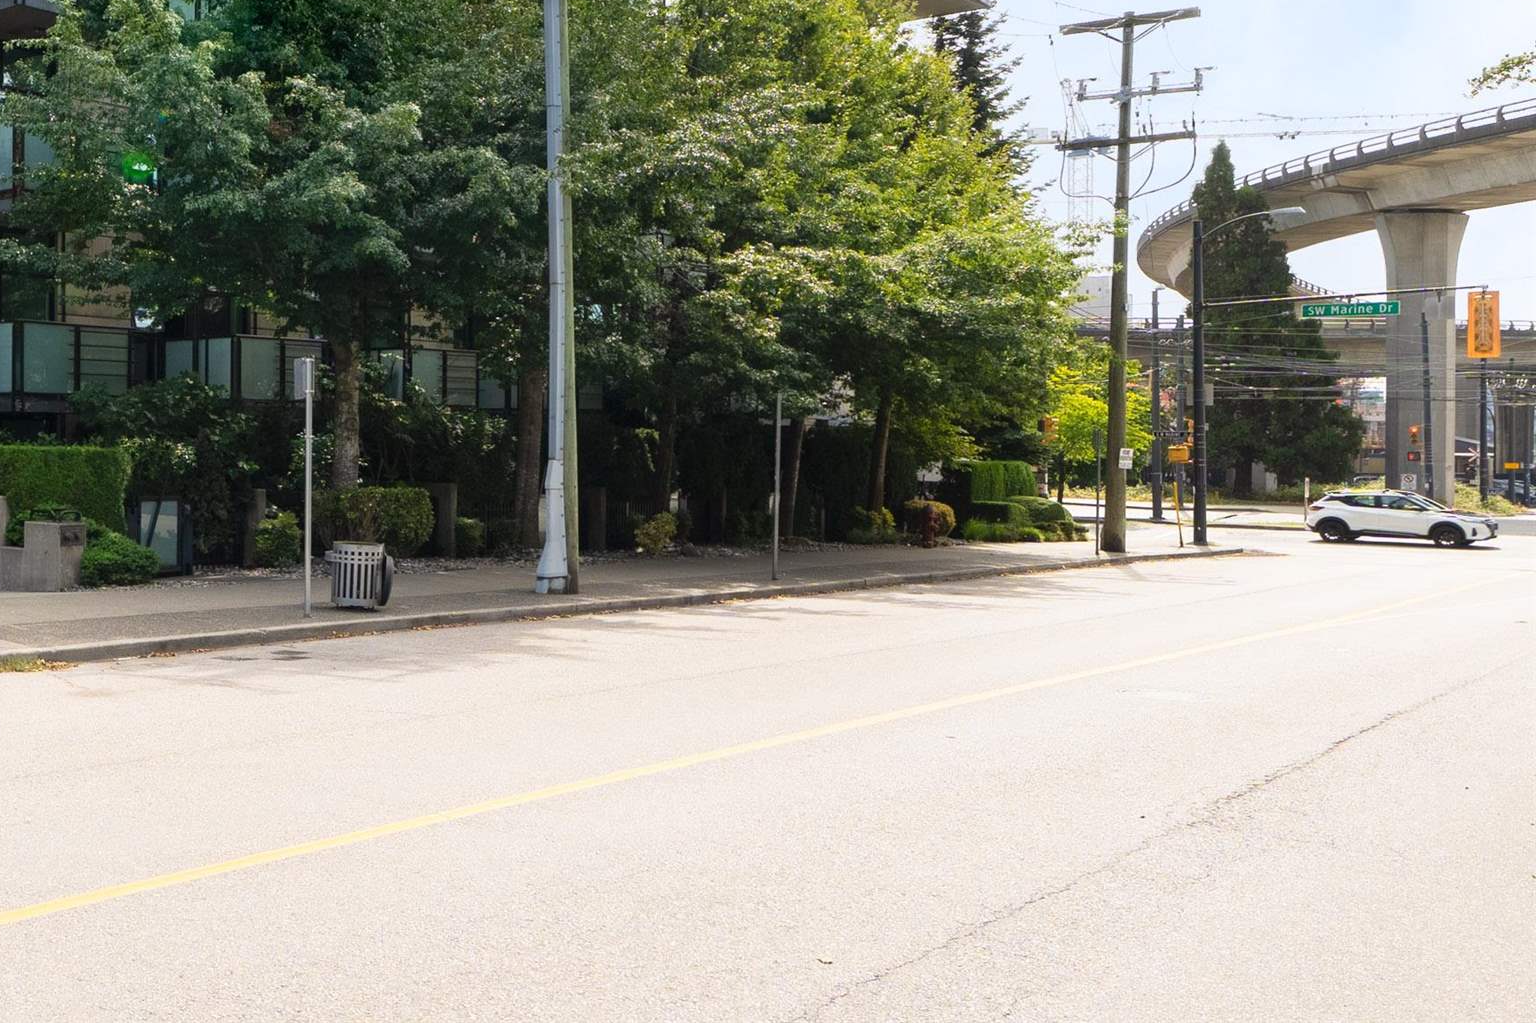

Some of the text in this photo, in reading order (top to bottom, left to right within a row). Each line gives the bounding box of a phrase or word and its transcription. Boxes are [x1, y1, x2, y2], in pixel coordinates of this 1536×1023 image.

[1308, 303, 1393, 316] SW Marine Dr
